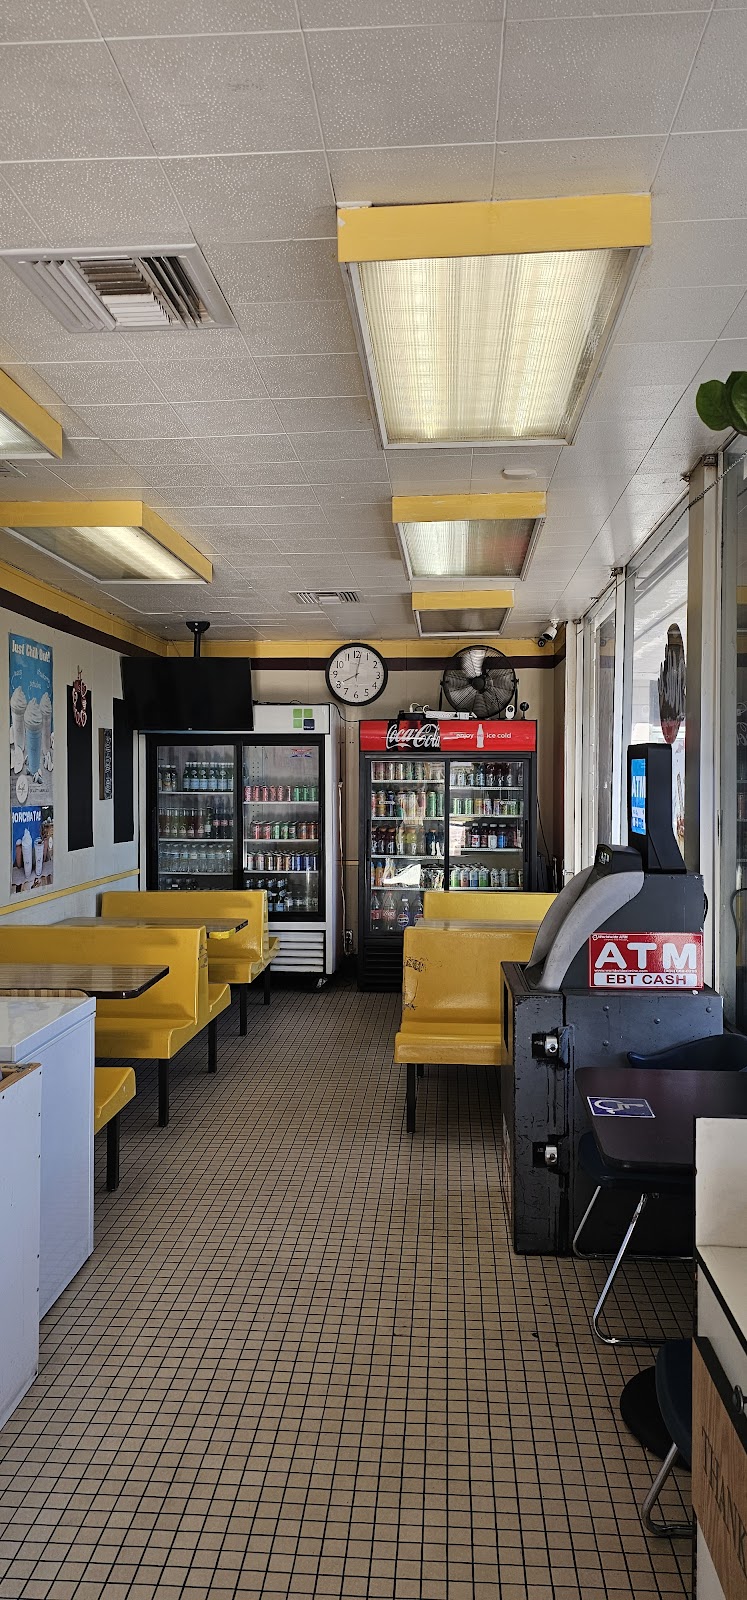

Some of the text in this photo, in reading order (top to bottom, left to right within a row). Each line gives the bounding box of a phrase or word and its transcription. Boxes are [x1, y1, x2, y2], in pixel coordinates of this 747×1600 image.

[12, 639, 51, 663] Just Chill Out!
[353, 650, 362, 659] 12
[345, 653, 350, 661] 11
[336, 660, 344, 669] 10
[373, 660, 378, 669] 2
[332, 670, 338, 678] 9
[376, 671, 381, 680] 3
[335, 680, 342, 689] 8
[372, 681, 377, 690] 4
[343, 687, 349, 695] 7
[353, 690, 359, 699] 6
[364, 688, 369, 697] 5
[455, 732, 474, 740] enjoy
[631, 775, 647, 799] ATM
[594, 941, 697, 970] ATM
[606, 974, 687, 985] EBT CASH
[701, 1425, 747, 1582] THANK
